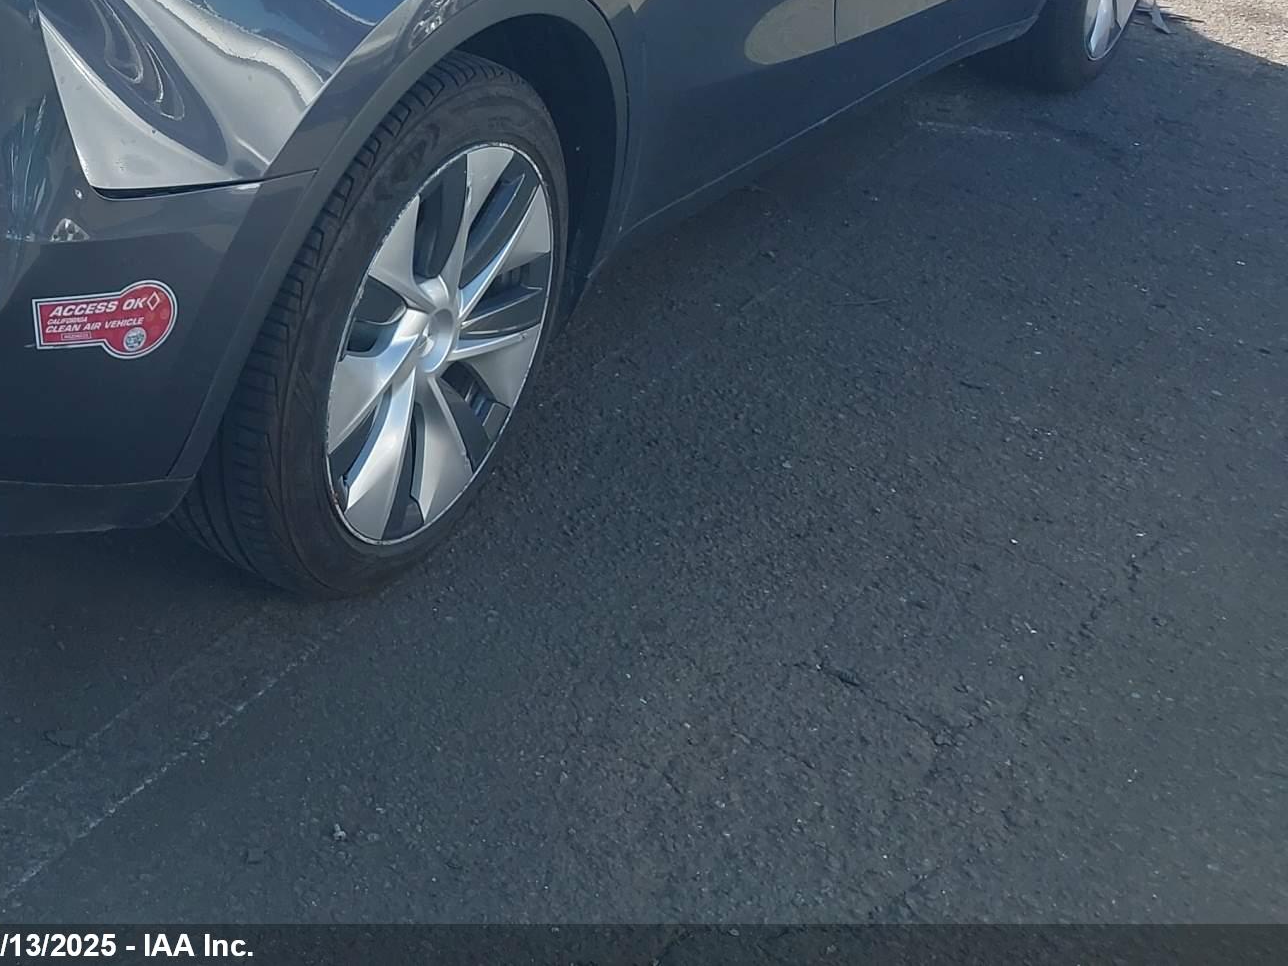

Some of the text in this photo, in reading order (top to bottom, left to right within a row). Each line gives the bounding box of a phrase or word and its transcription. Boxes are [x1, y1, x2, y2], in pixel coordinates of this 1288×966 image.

[49, 297, 147, 317] ACCESS OK
[45, 317, 144, 333] CLEAN AIR VEHICLE
